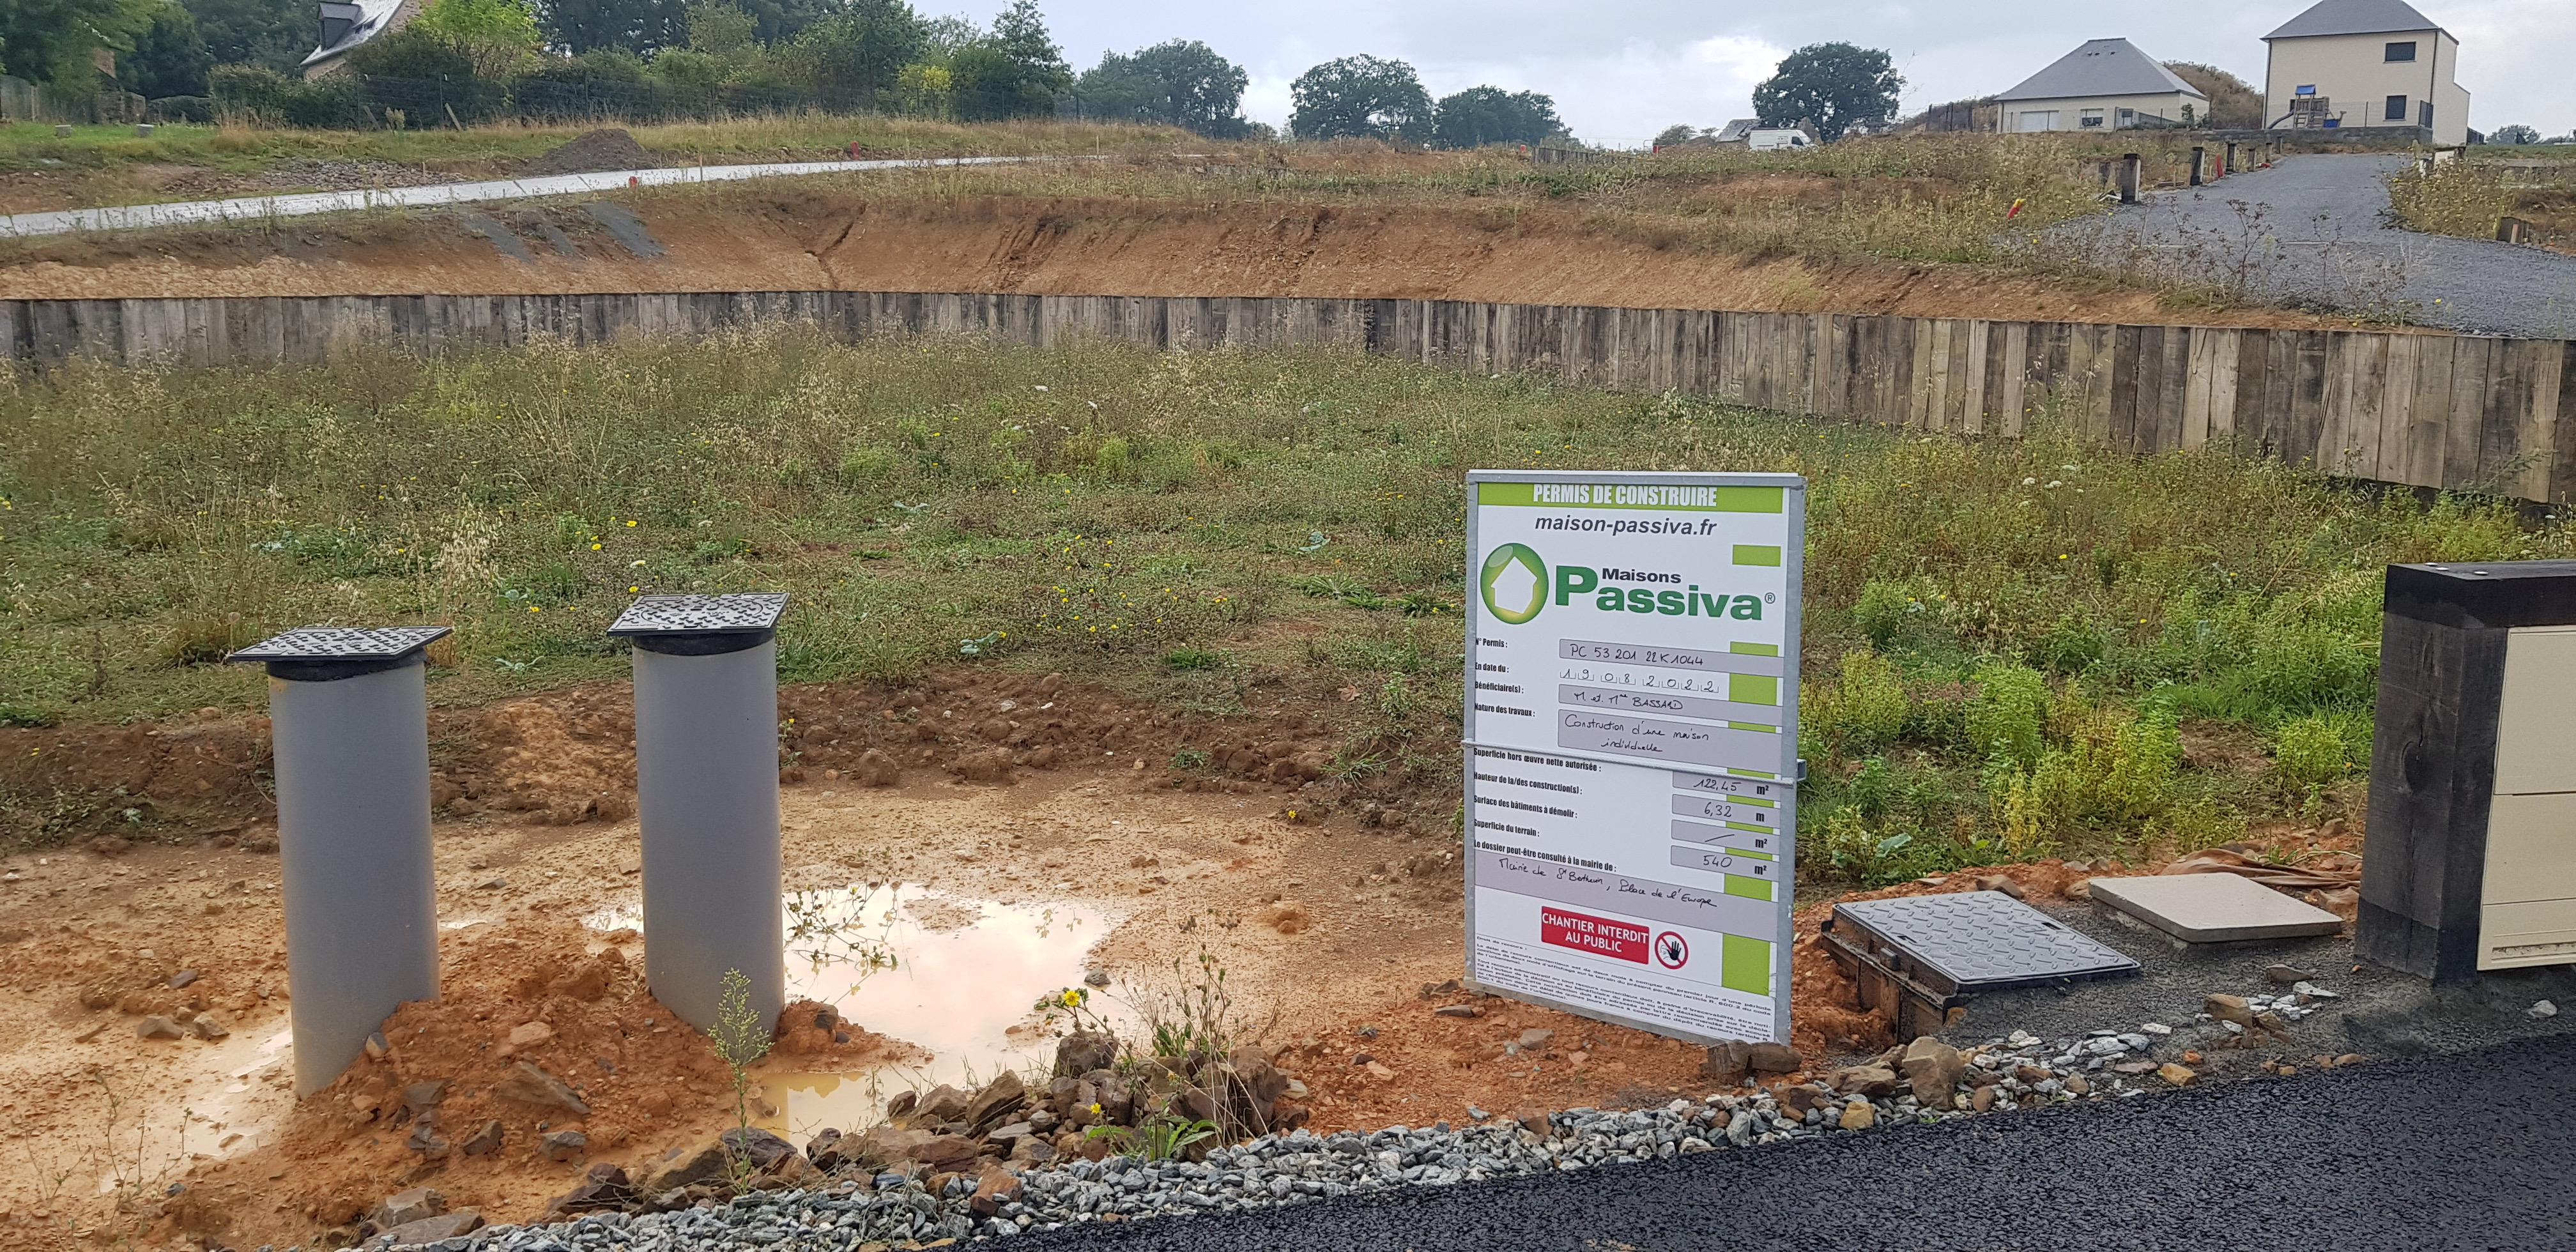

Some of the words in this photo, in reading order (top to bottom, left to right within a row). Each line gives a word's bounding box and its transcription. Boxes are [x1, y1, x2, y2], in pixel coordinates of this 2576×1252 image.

[1533, 484, 1590, 503] PERMIS
[1593, 485, 1612, 503] DE
[1616, 485, 1717, 507] CONSTRUIRE
[1535, 515, 1717, 535] maison-passiva.fr
[1602, 569, 1681, 583] Maisons
[1483, 639, 1504, 647] Permis
[1570, 644, 1586, 657] PC
[1595, 647, 1609, 658] 53
[1615, 651, 1636, 660] 201
[1483, 663, 1496, 671] date
[1475, 682, 1520, 693] Bénéficiaire(s)
[1475, 703, 1494, 712] Nature
[1496, 705, 1506, 714] des
[1508, 707, 1531, 716] travaux
[1565, 714, 1624, 731] Construction
[1632, 721, 1665, 735] d'une
[1673, 728, 1708, 740] maison
[1474, 748, 1506, 759] Superficie
[1508, 752, 1522, 761] hors
[1566, 761, 1597, 771] autorisée
[1474, 772, 1498, 782] Hauteur
[1508, 777, 1528, 786] la/des
[1529, 780, 1579, 793] construction(s)
[1693, 778, 1741, 791] 122,45
[1474, 795, 1496, 805] Surface
[1499, 799, 1509, 807] des
[1511, 800, 1542, 813] bâtiments
[1544, 805, 1547, 814] à
[1549, 807, 1574, 818] démolir
[1705, 802, 1731, 818] 6,32
[1756, 813, 1764, 821] m
[1474, 819, 1505, 831] Superficie
[1506, 824, 1514, 832] du
[1515, 826, 1536, 836] terrain
[1482, 841, 1505, 852] dossier
[1507, 846, 1536, 858] peut-être
[1538, 851, 1566, 862] consulté
[1568, 855, 1572, 864] à
[1574, 857, 1579, 865] la
[1581, 859, 1602, 869] mairie
[1605, 862, 1613, 871] de
[1703, 855, 1731, 867] 540
[1499, 859, 1528, 872] Mairie
[1533, 865, 1546, 876] de
[1652, 889, 1662, 897] de
[1542, 912, 1594, 933] CHANTIER
[1598, 924, 1648, 943] INTERDIT
[1565, 931, 1580, 942] AU
[1584, 935, 1622, 952] PUBLIC
